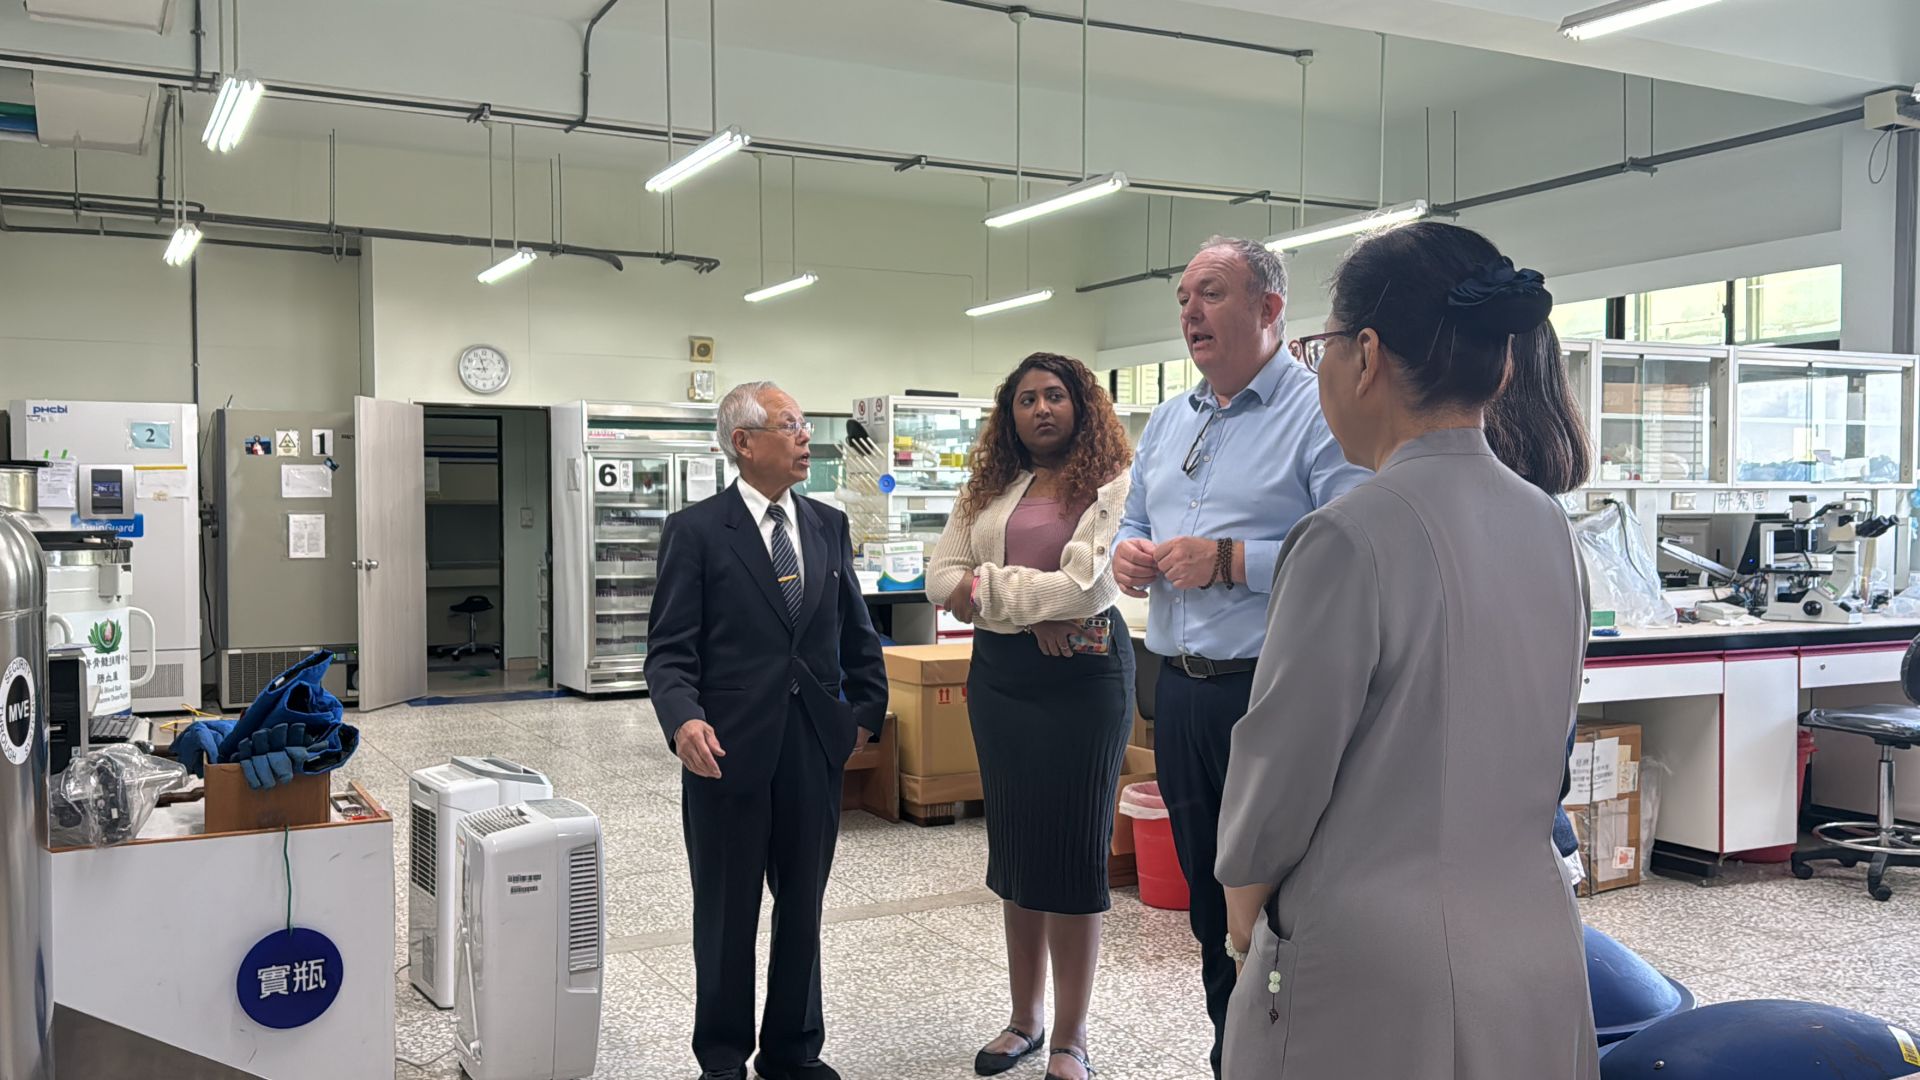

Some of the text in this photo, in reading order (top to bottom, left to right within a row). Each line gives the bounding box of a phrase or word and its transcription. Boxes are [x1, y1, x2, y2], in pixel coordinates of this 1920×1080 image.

[145, 428, 155, 442] 2
[316, 432, 328, 455] 1
[598, 463, 618, 487] 6
[4, 658, 31, 685] SECURITY
[8, 700, 30, 723] MVE
[257, 959, 327, 999] 實瓶
